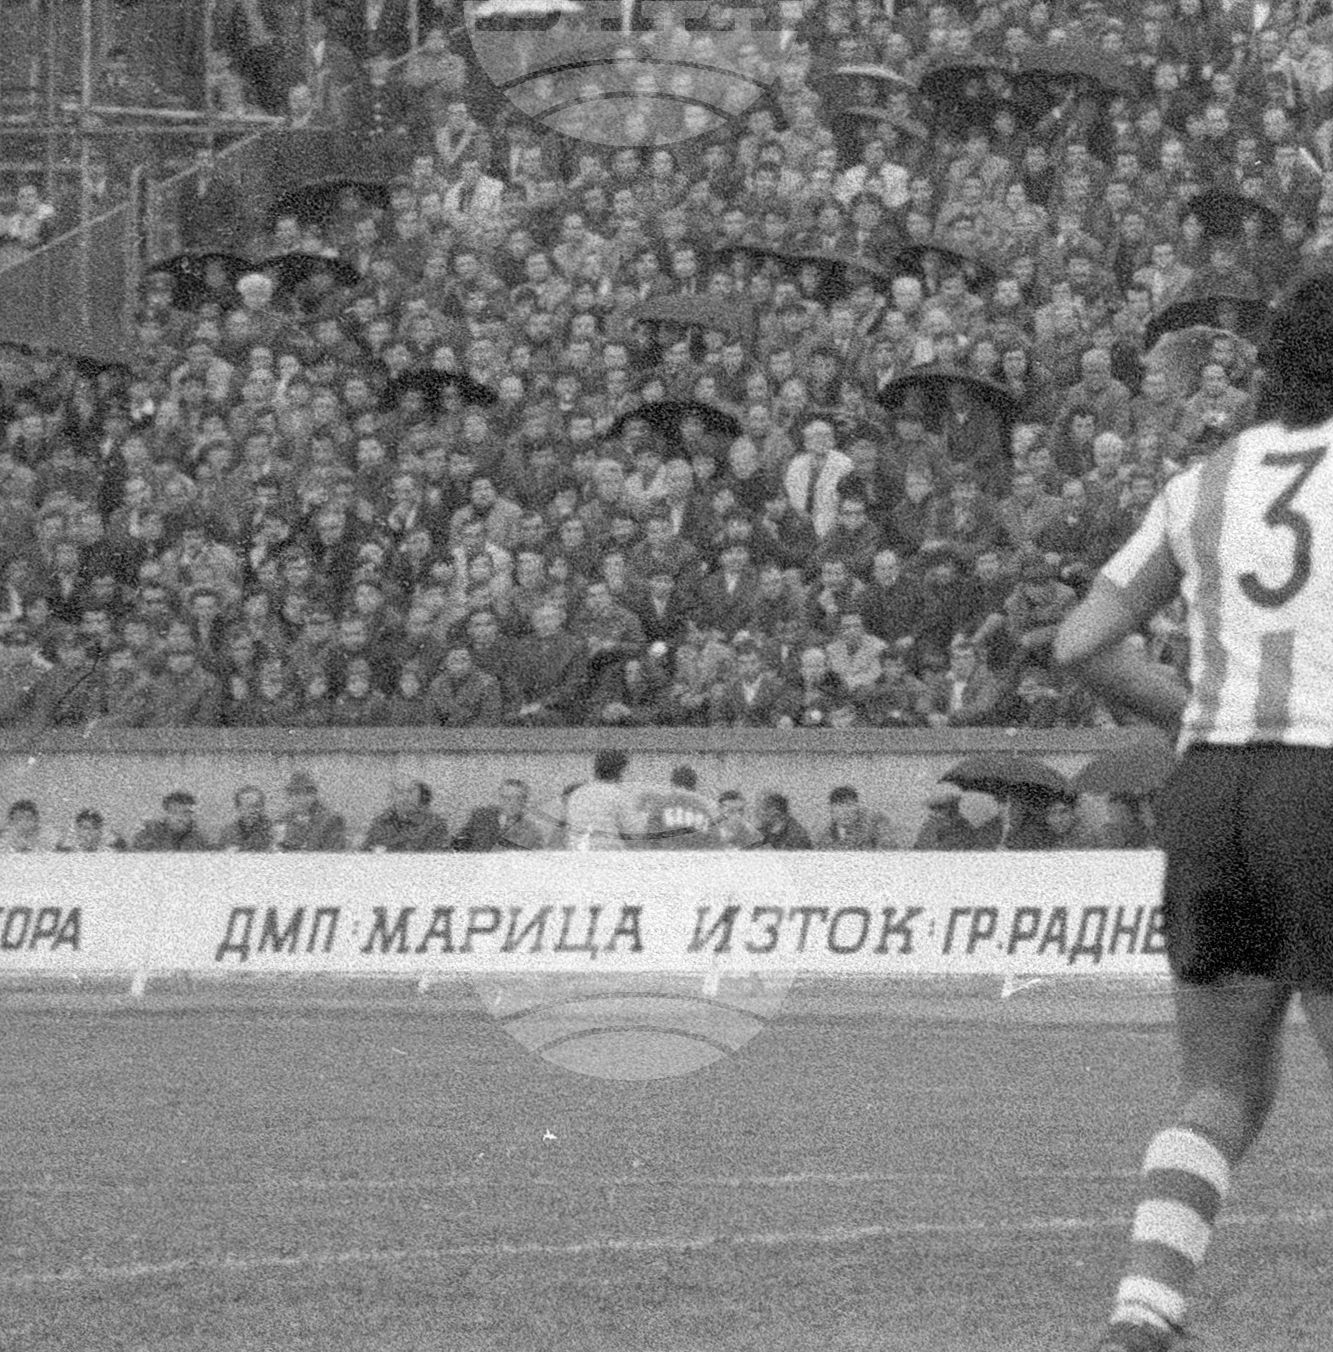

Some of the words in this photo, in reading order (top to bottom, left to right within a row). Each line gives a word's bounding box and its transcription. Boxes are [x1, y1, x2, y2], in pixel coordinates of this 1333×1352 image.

[1238, 445, 1328, 608] 3
[0, 905, 82, 951] ОРА
[215, 905, 341, 962] ДМП
[360, 905, 644, 960] МАРИЦА
[686, 904, 925, 955] ИЗТОК
